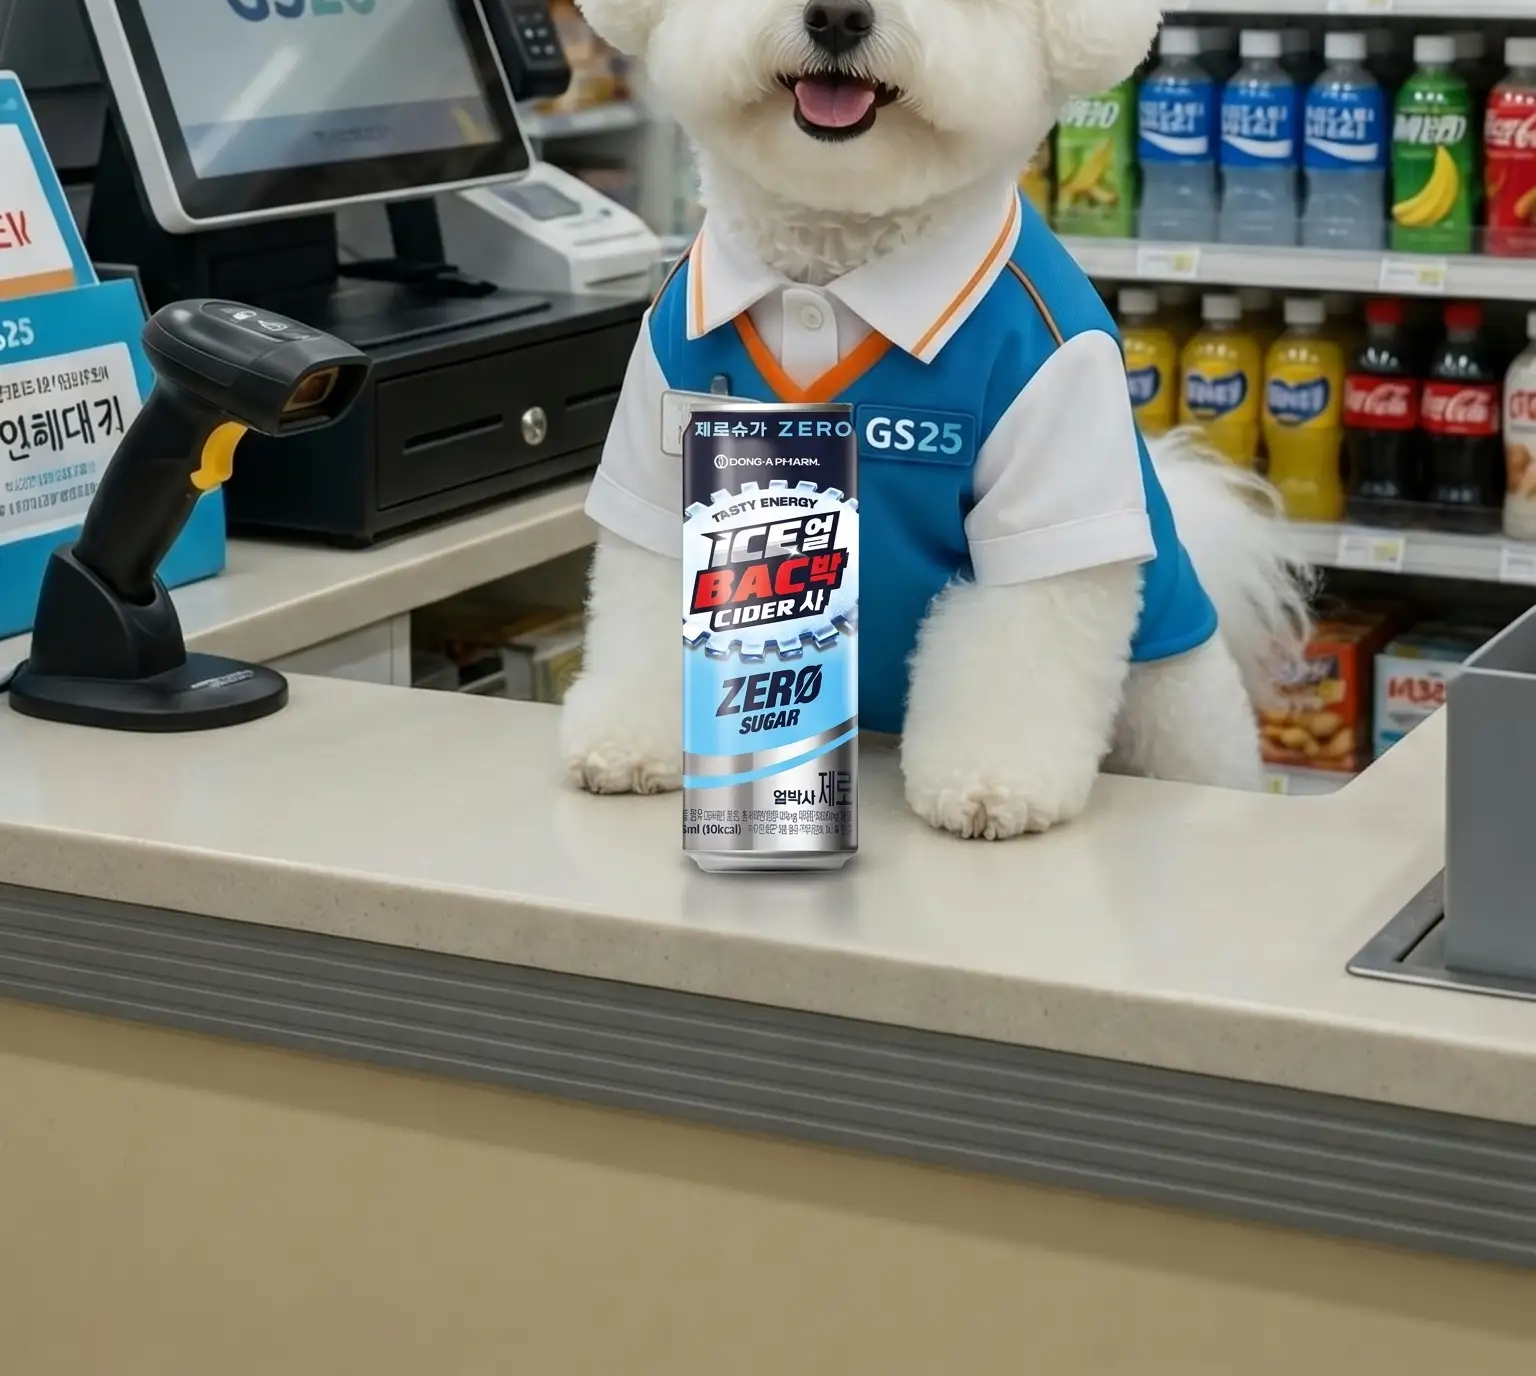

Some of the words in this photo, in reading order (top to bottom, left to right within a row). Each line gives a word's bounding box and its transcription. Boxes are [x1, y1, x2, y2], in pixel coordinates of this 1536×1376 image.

[695, 421, 767, 437] 제로슈가
[779, 421, 852, 437] ZERO
[866, 417, 962, 454] GS25
[712, 500, 757, 523] TASTY
[761, 497, 819, 509] ENERGY
[714, 599, 795, 628] CIDER
[799, 589, 825, 612] 사
[739, 708, 801, 734] SUGAR
[819, 770, 853, 807] 제로
